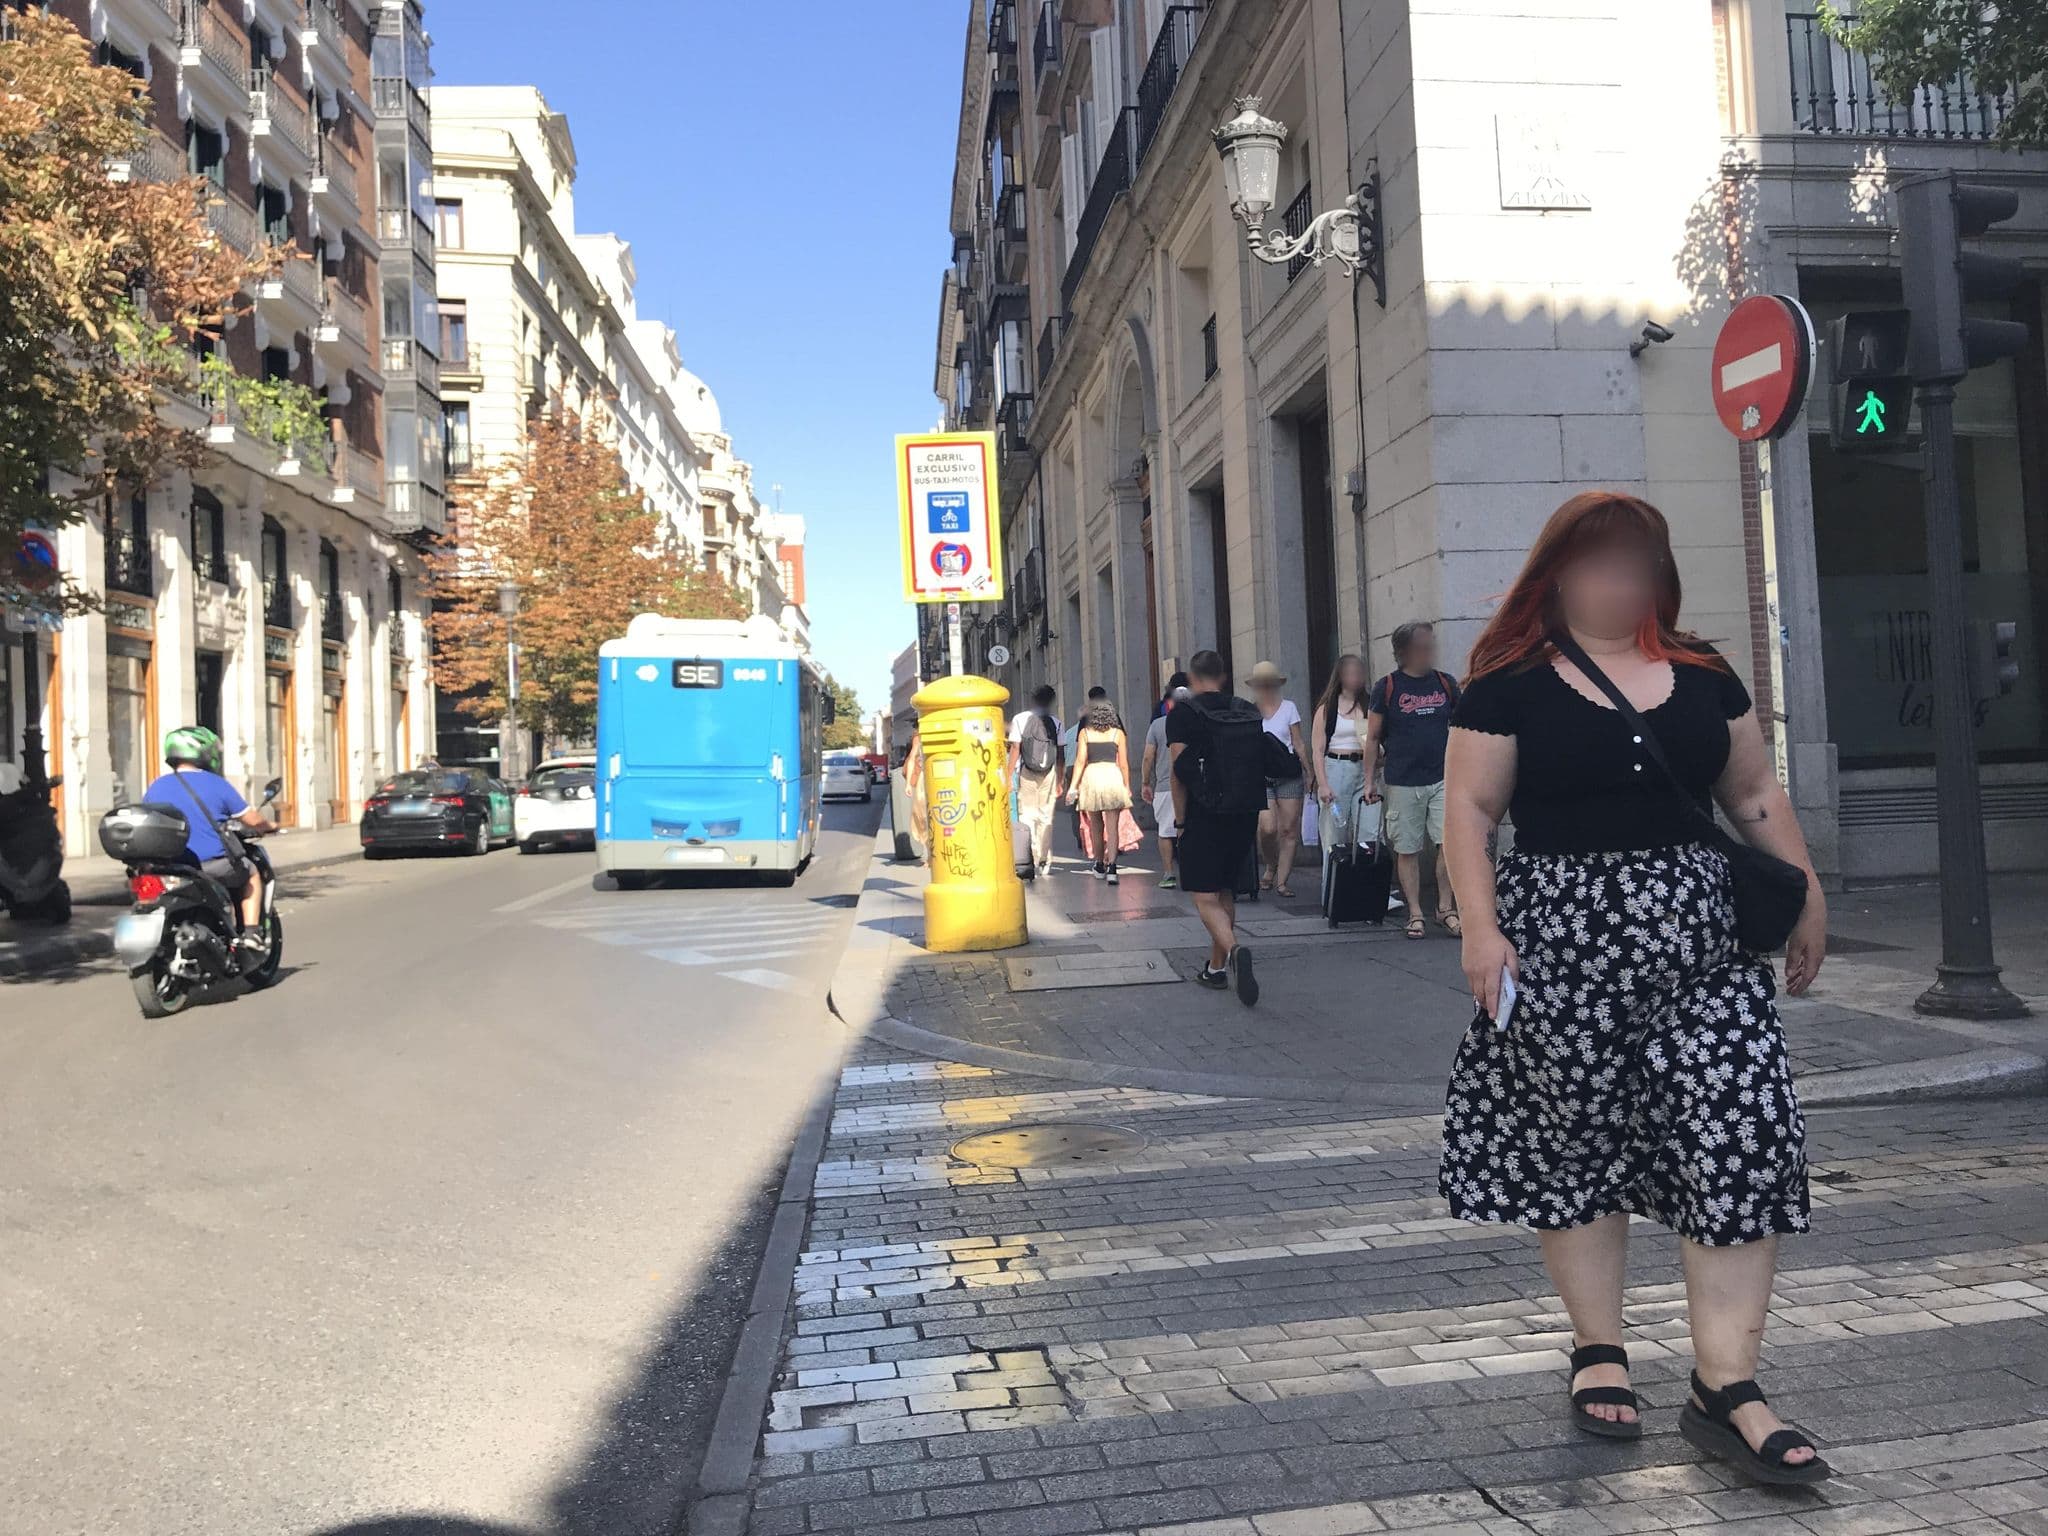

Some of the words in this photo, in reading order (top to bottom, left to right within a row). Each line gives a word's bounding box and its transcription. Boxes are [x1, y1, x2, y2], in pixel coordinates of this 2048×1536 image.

[927, 453, 964, 462] CARRIL
[917, 464, 976, 473] EXCLUSIVO
[914, 476, 980, 485] BUS-TAXI-MOTOS
[679, 665, 716, 685] SE
